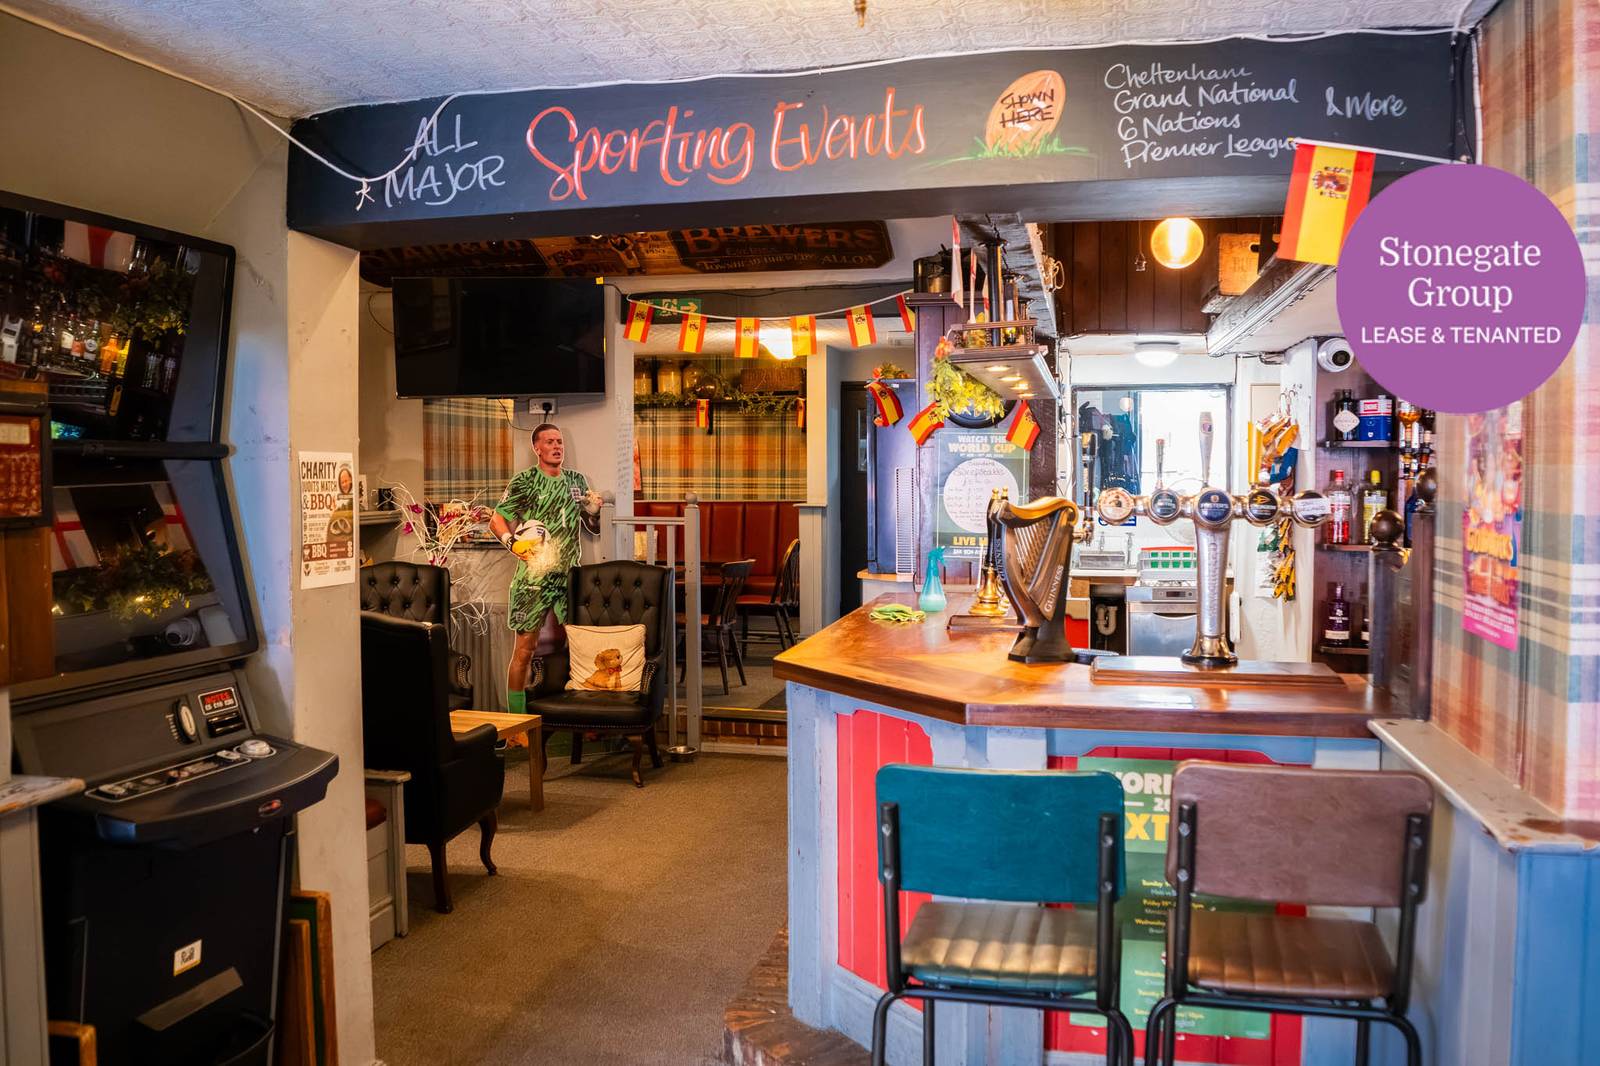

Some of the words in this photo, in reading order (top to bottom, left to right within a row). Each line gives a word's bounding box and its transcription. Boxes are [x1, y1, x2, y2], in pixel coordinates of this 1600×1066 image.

[1104, 63, 1252, 89] Cheltenham
[1000, 89, 1055, 110] SHOWN
[1113, 86, 1193, 114] Grand
[1198, 78, 1300, 108] National
[1325, 86, 1345, 117] &
[1345, 92, 1408, 121] More
[999, 105, 1055, 129] HERE
[1117, 116, 1138, 141] 6
[1142, 111, 1241, 139] Nations
[404, 113, 478, 160] ALL
[525, 105, 756, 201] Sporting
[770, 87, 928, 173] Events
[1120, 137, 1225, 169] Premier
[384, 155, 506, 207] MAJOR
[680, 222, 883, 255] BREWERS
[948, 443, 990, 453] WORLD
[993, 443, 1017, 454] CUP
[958, 434, 988, 444] WATCH
[301, 461, 337, 480] CHARITY
[310, 493, 333, 511] BBQ
[311, 543, 327, 559] BBQ
[953, 536, 976, 546] LIVE
[1043, 564, 1064, 612] GUINNESS
